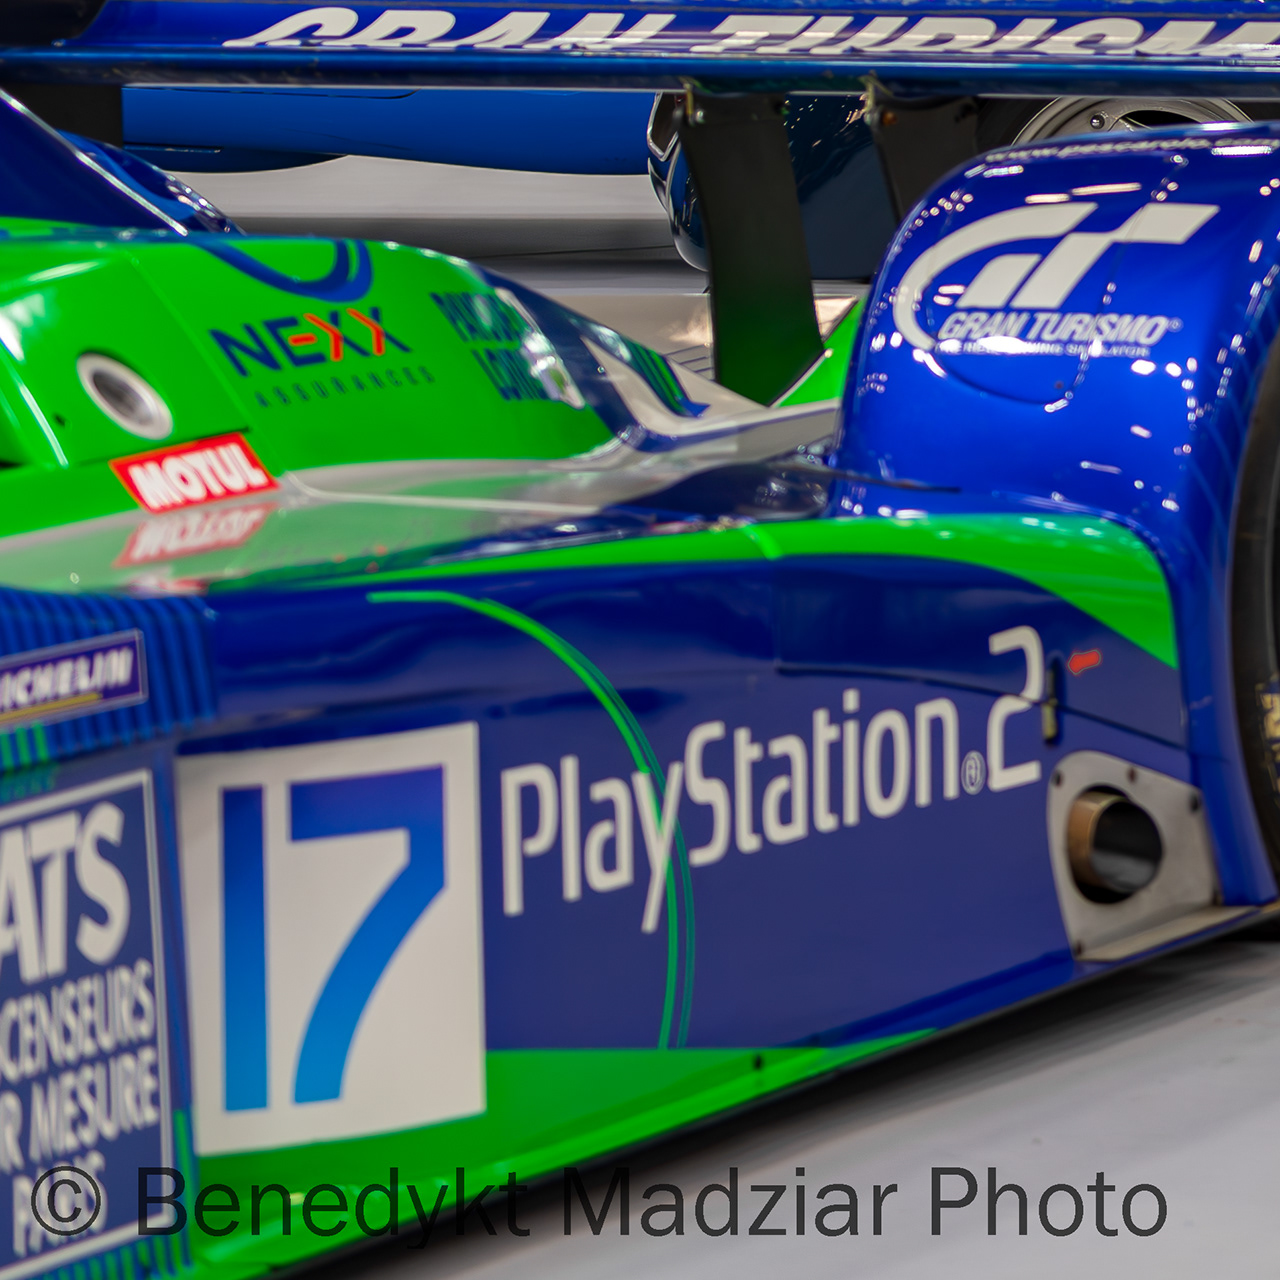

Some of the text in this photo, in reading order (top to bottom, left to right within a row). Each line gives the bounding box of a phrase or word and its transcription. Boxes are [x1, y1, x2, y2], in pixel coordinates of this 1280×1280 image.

[208, 305, 412, 379] NEXX
[938, 311, 1031, 343] GRAN
[128, 442, 269, 510] MOTUL
[220, 762, 447, 1114] 17
[29, 1047, 161, 1163] MESURE
